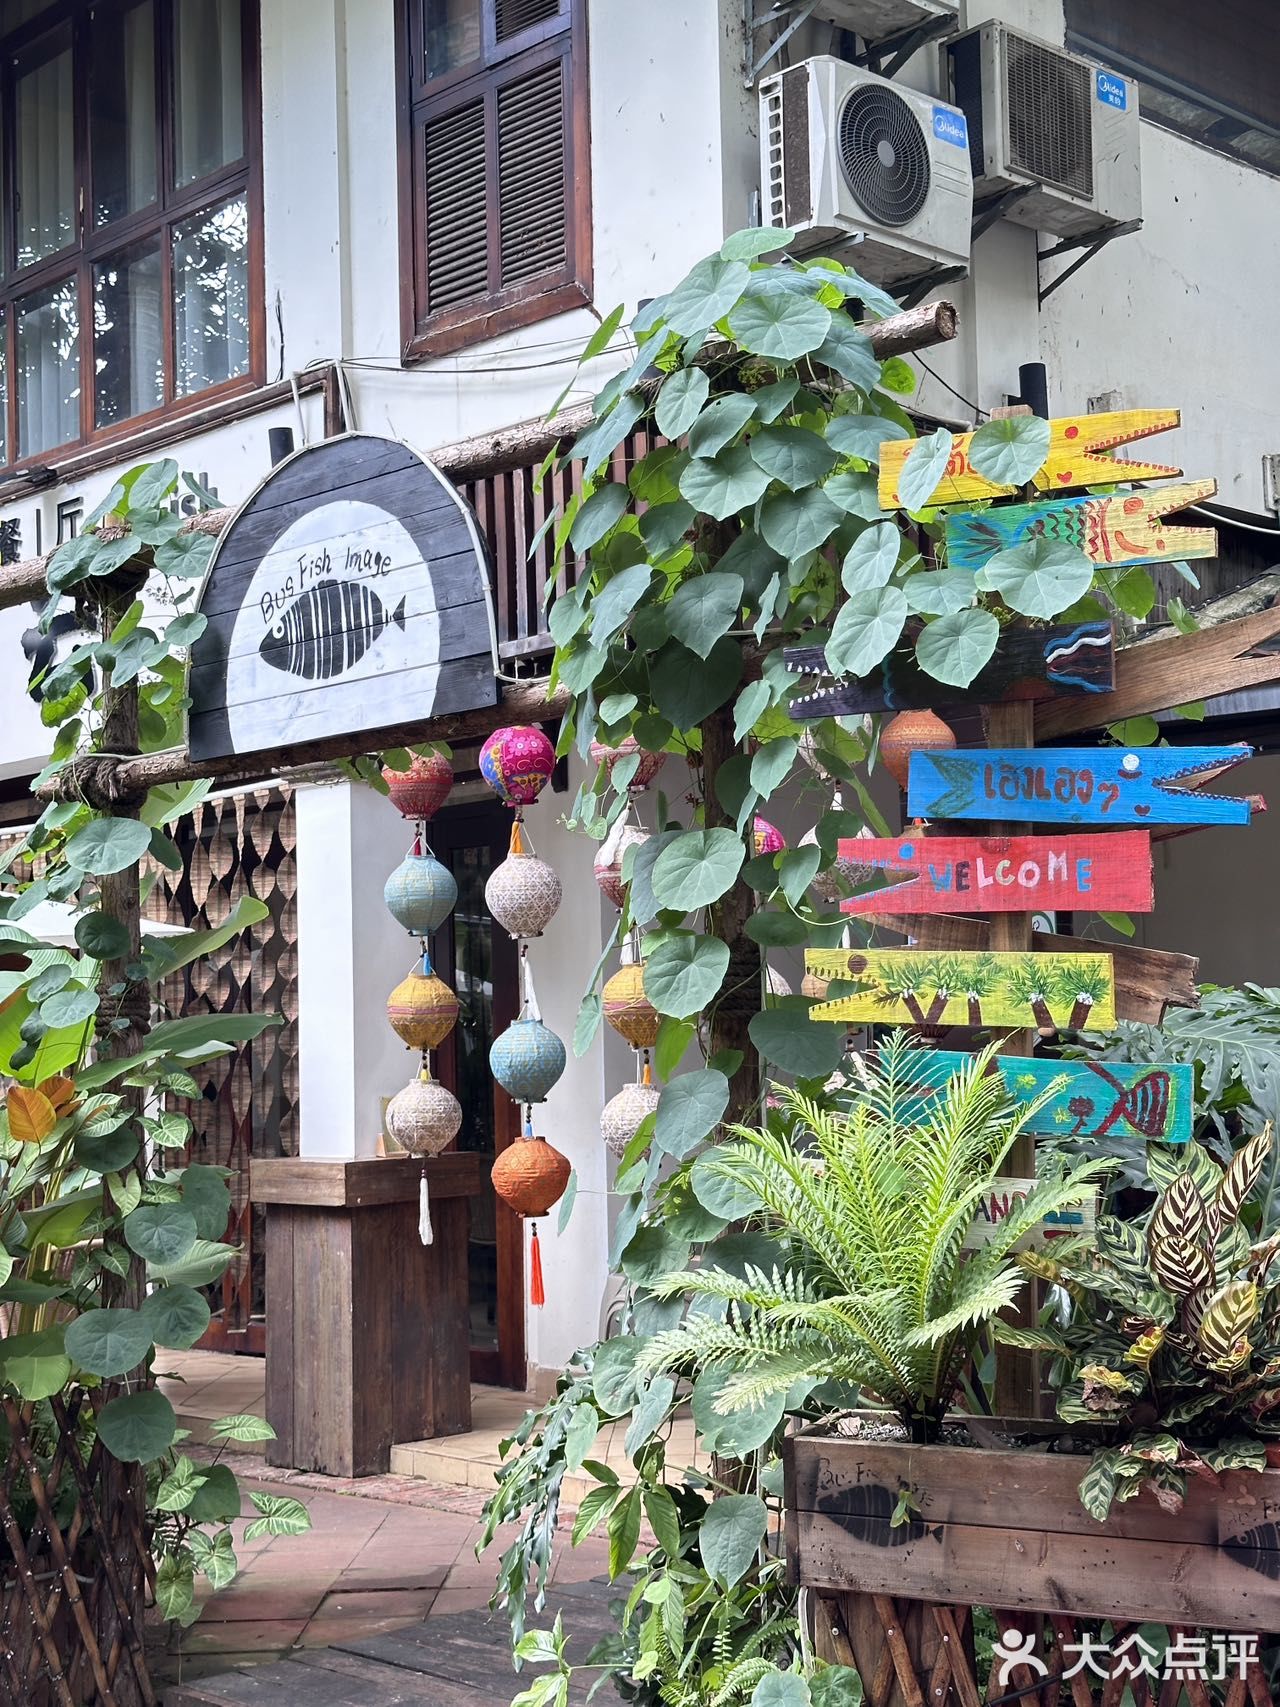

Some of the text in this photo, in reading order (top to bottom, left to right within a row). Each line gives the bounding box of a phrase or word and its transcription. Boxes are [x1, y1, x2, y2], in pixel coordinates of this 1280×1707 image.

[935, 115, 964, 139] Midea
[260, 546, 392, 624] Bus Fish Image
[928, 850, 1093, 893] WELCOME
